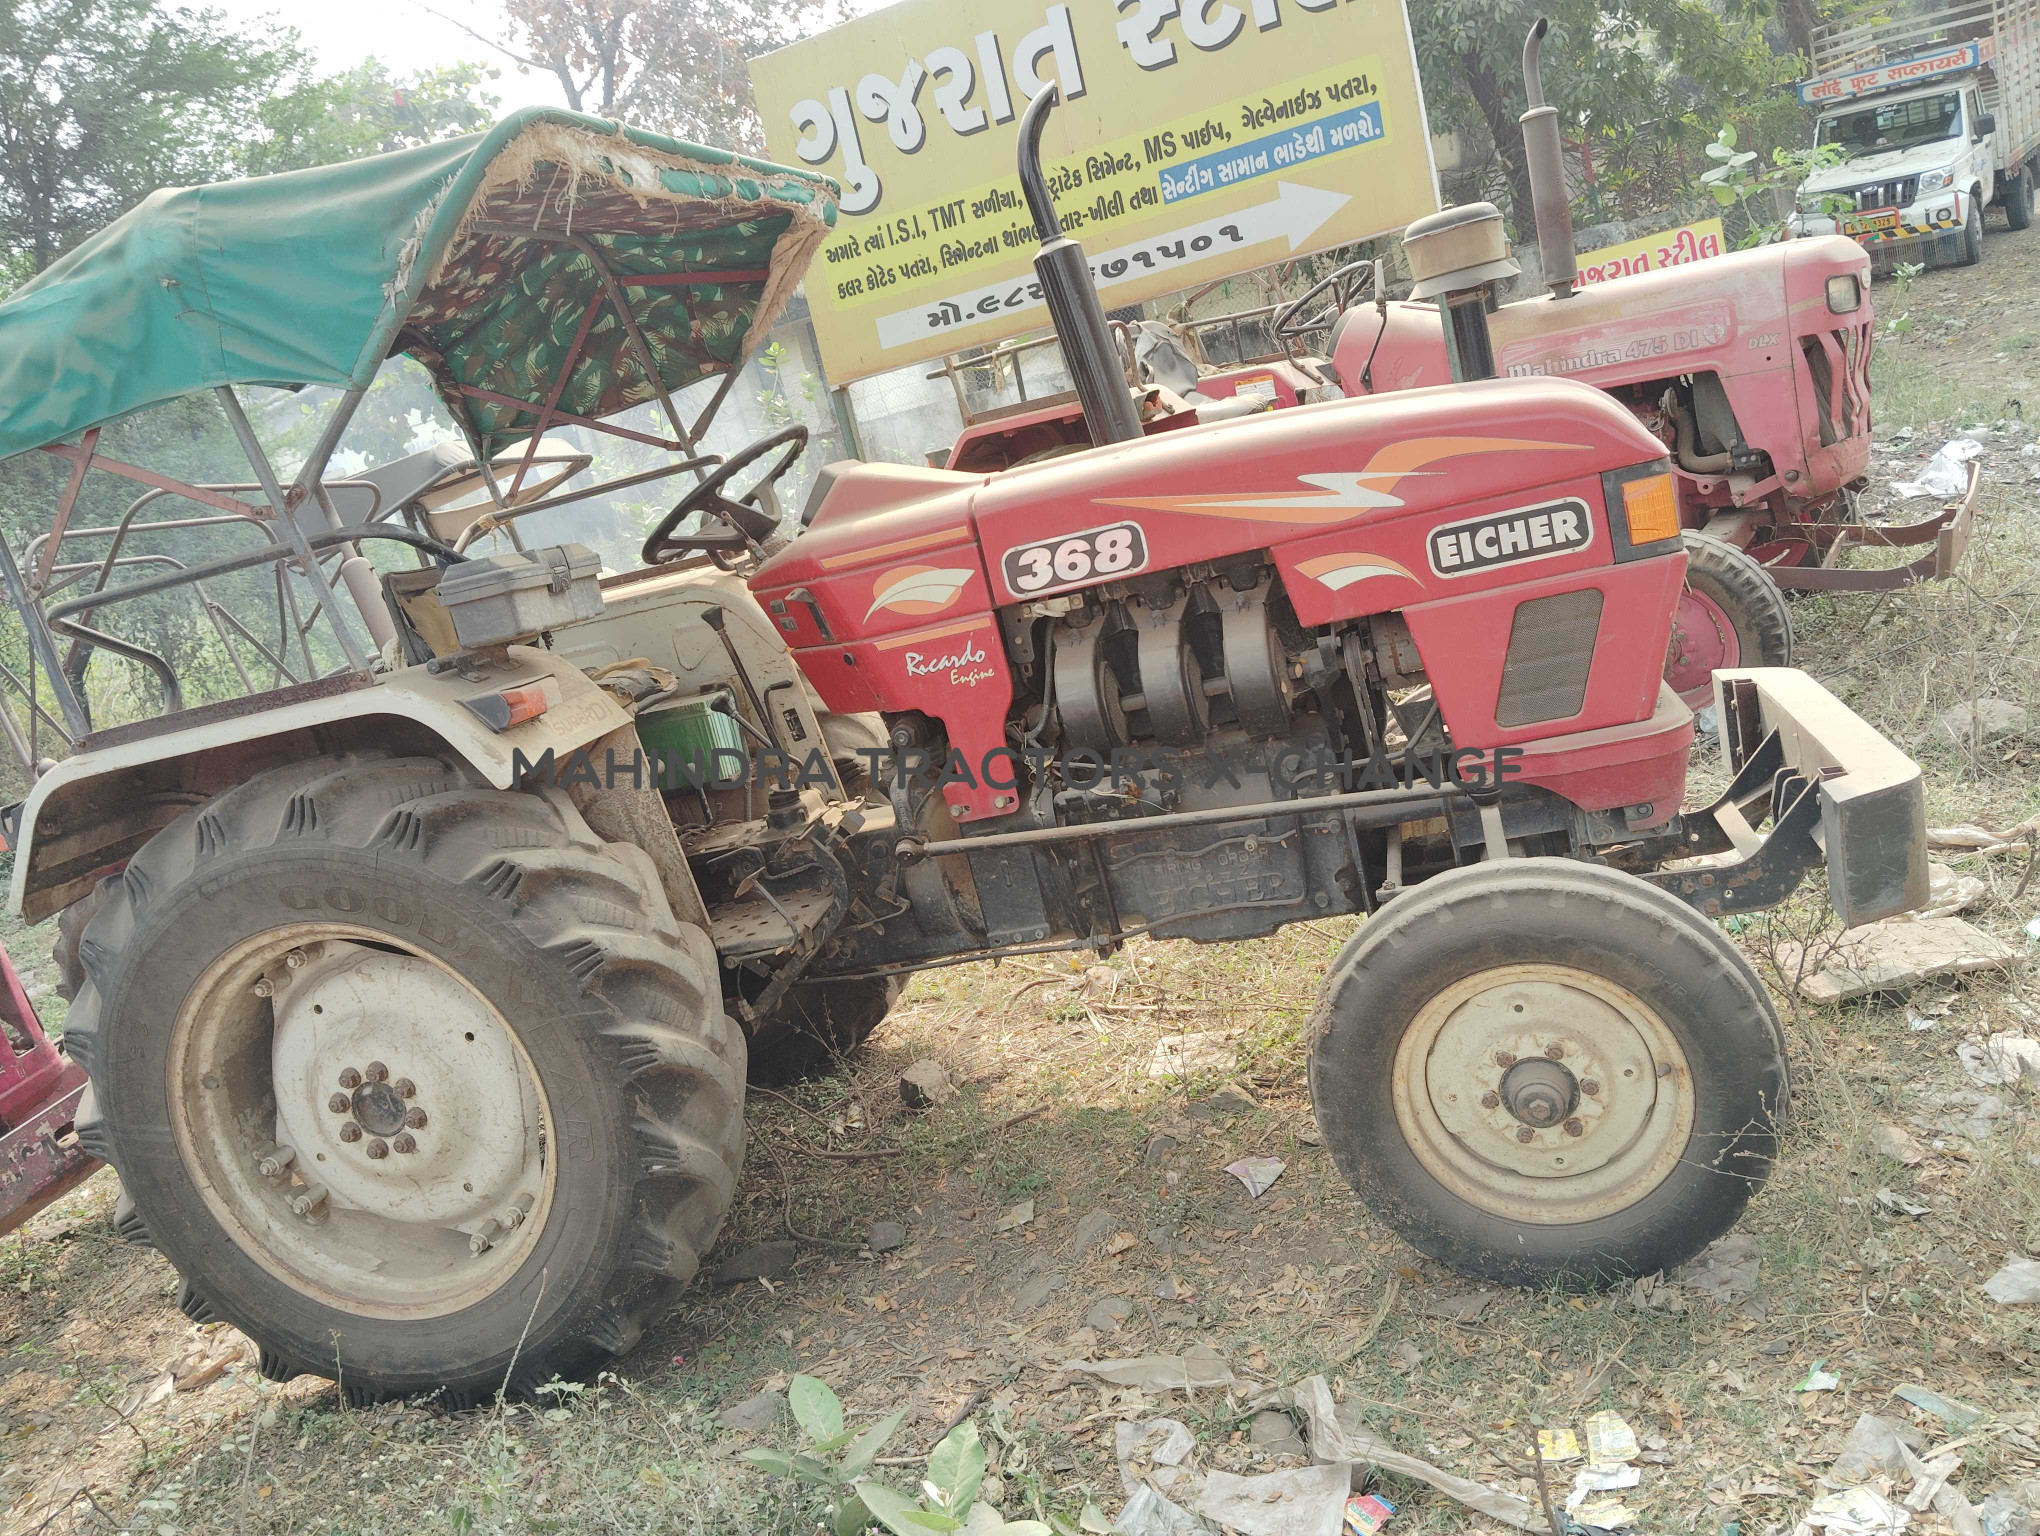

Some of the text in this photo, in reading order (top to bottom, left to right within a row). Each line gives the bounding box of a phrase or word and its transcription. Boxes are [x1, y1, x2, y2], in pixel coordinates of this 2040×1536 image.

[788, 3, 1086, 215] ગુજરાત
[825, 234, 862, 263] અમારે
[927, 199, 967, 233] TMT
[1085, 151, 1141, 184] સિમેન્ટ,
[1143, 131, 1178, 164] MS
[1325, 74, 1377, 103] પતરા,
[837, 278, 864, 300] કલર
[866, 264, 897, 291] કોટેડ
[898, 256, 938, 280] પતરા,
[1129, 185, 1159, 211] તથા
[1217, 150, 1269, 182] સામાન
[1272, 126, 1326, 166] ભાડેથી
[1507, 330, 1699, 378] Mahindra 475 DI
[1747, 333, 1781, 350] DLX
[1014, 527, 1134, 591] 368
[1436, 506, 1584, 570] EICHER
[905, 640, 986, 677] Ricardo
[950, 668, 995, 688] Engine
[1149, 871, 1292, 918] EICHER
[279, 884, 597, 1163] GOODYEAR
